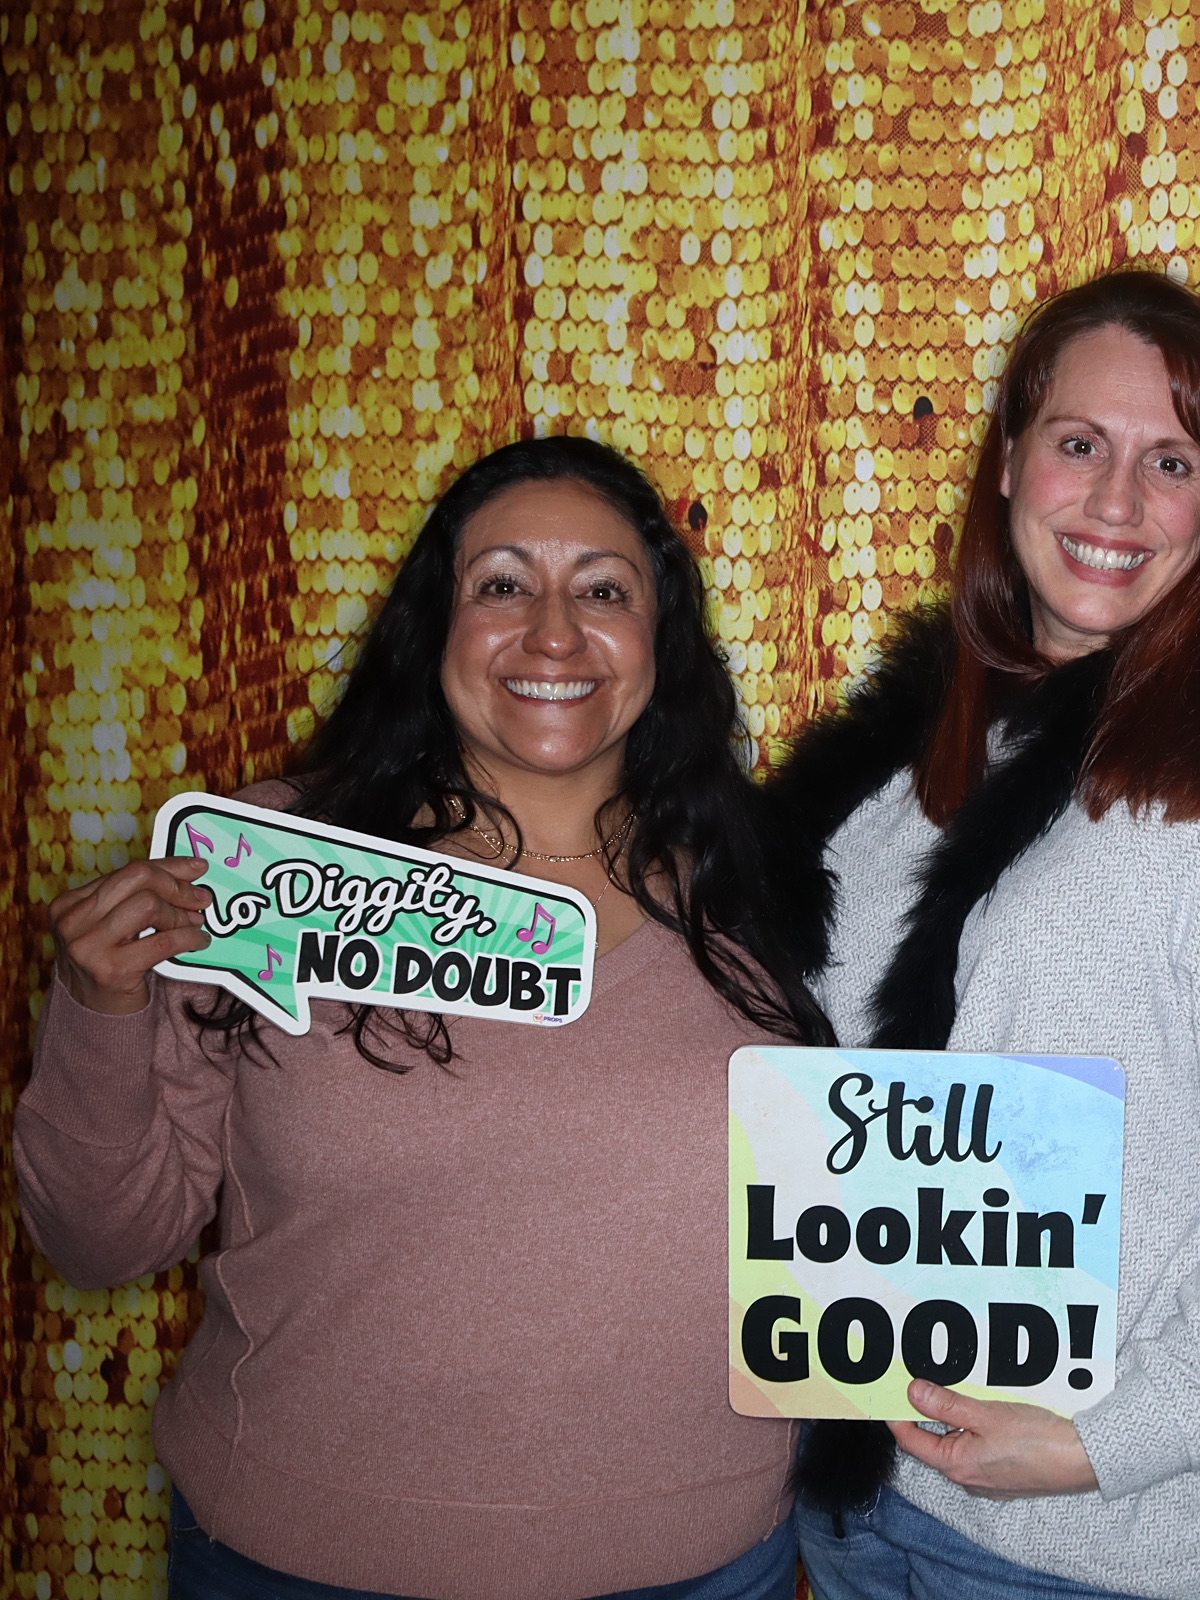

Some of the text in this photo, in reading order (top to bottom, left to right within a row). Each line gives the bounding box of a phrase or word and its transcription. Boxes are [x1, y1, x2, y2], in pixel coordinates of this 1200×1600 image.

[261, 858, 497, 944] Diggity,
[297, 931, 581, 1015] NO DOUBT
[543, 1015, 562, 1023] PROPS
[826, 1073, 1002, 1174] Still
[746, 1184, 1106, 1268] Lookin'
[741, 1295, 1099, 1390] GOOD!
